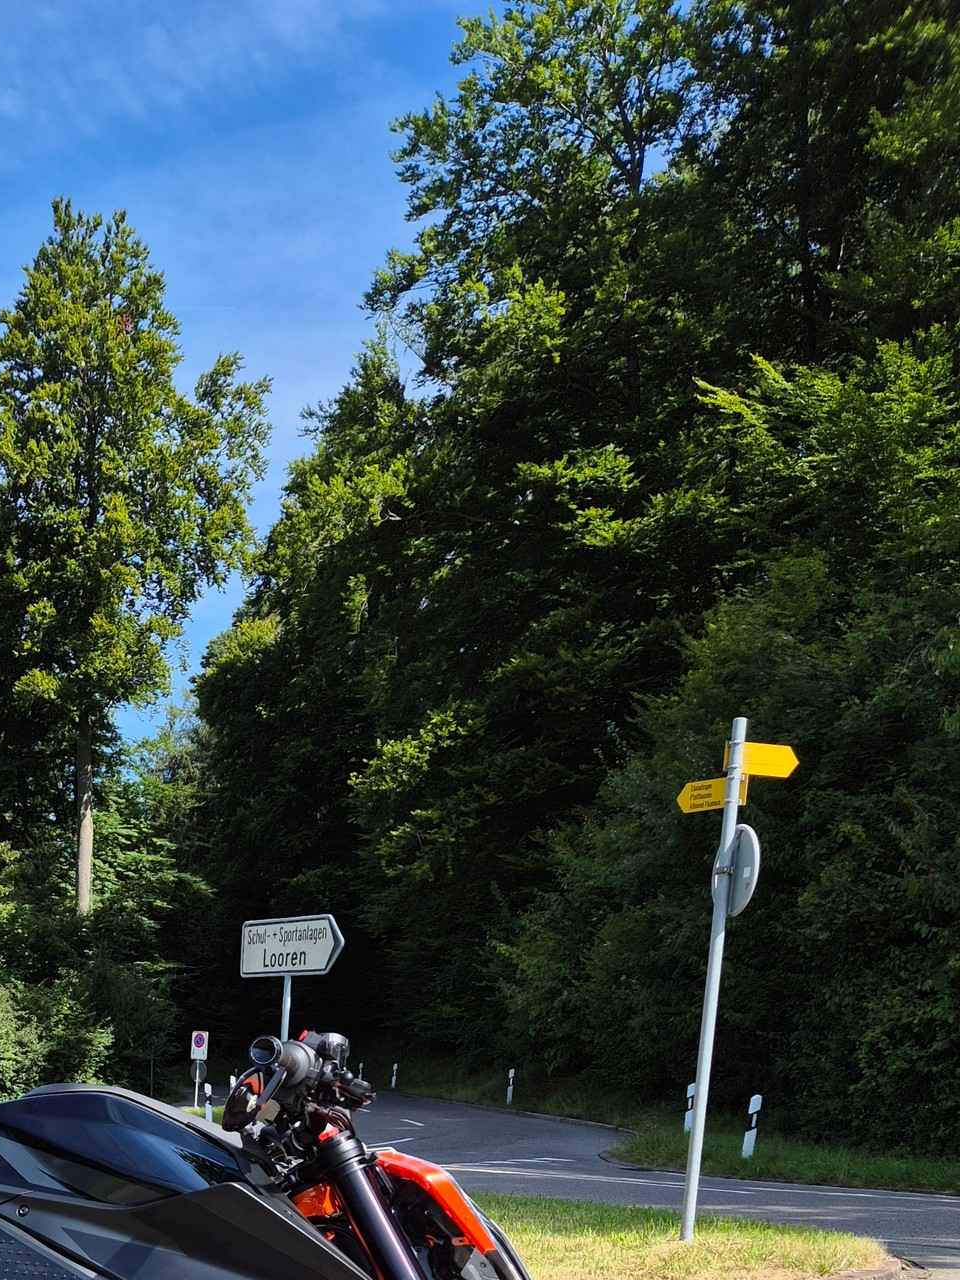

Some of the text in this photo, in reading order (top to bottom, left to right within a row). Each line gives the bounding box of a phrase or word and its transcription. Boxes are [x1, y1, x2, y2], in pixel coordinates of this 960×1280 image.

[247, 928, 270, 945] Schul-
[279, 925, 327, 946] Sportanlagen
[263, 949, 307, 968] Looren
